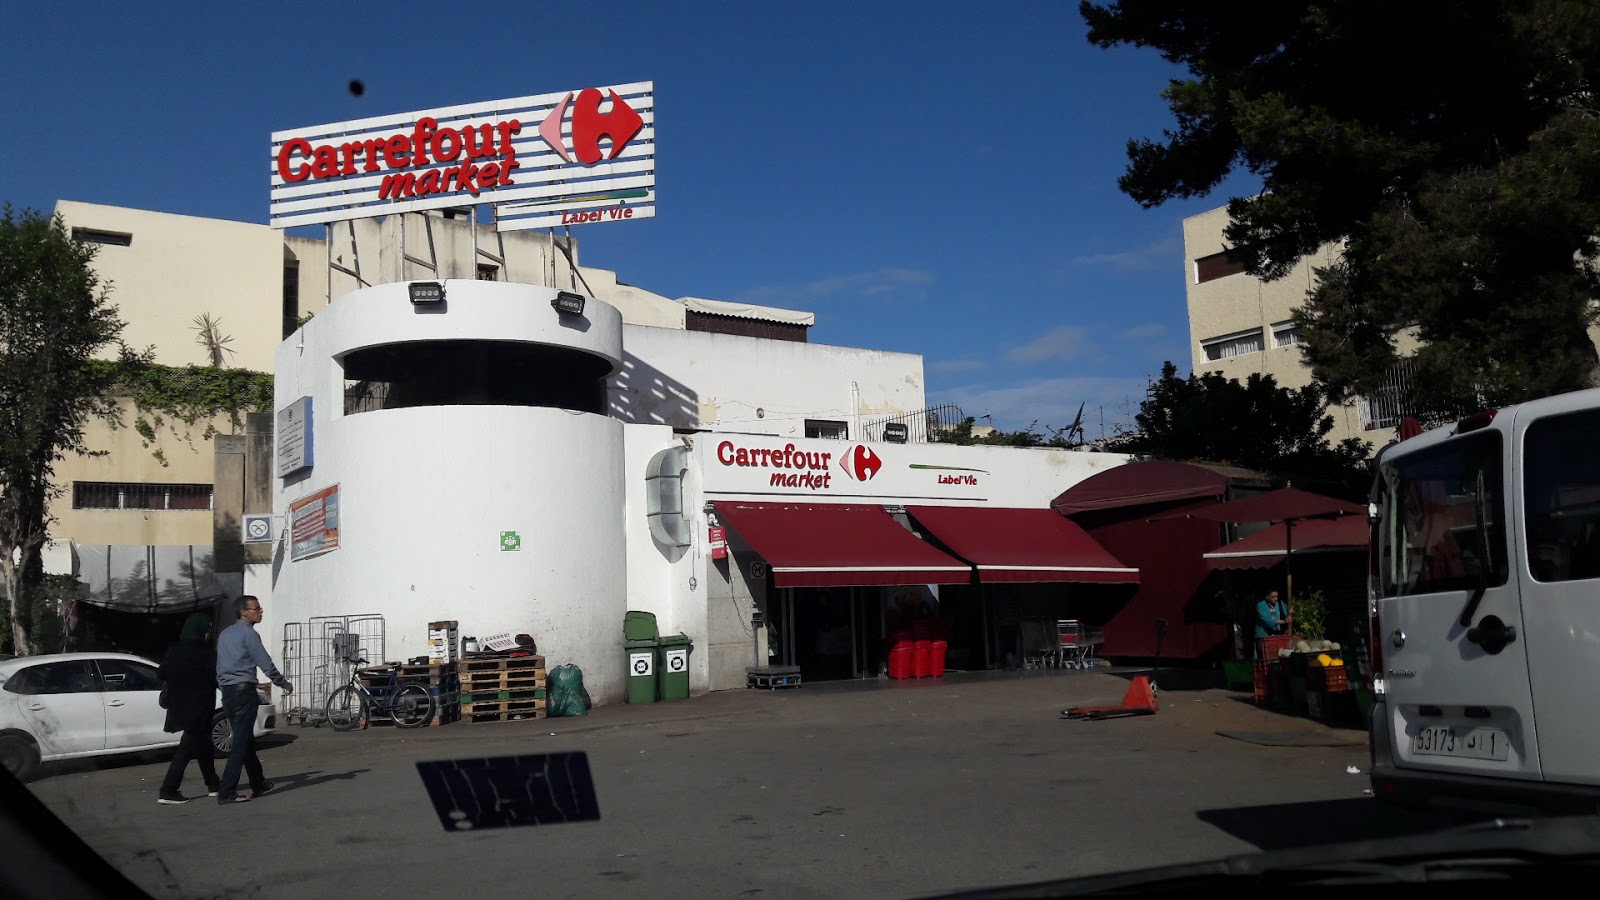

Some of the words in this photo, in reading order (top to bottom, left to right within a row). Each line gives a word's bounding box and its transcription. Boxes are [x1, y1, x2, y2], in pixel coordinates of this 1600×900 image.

[276, 116, 522, 183] Carrefour
[377, 153, 520, 200] market
[717, 440, 831, 470] Carrefour
[769, 471, 831, 490] market
[1417, 728, 1456, 752] 53173
